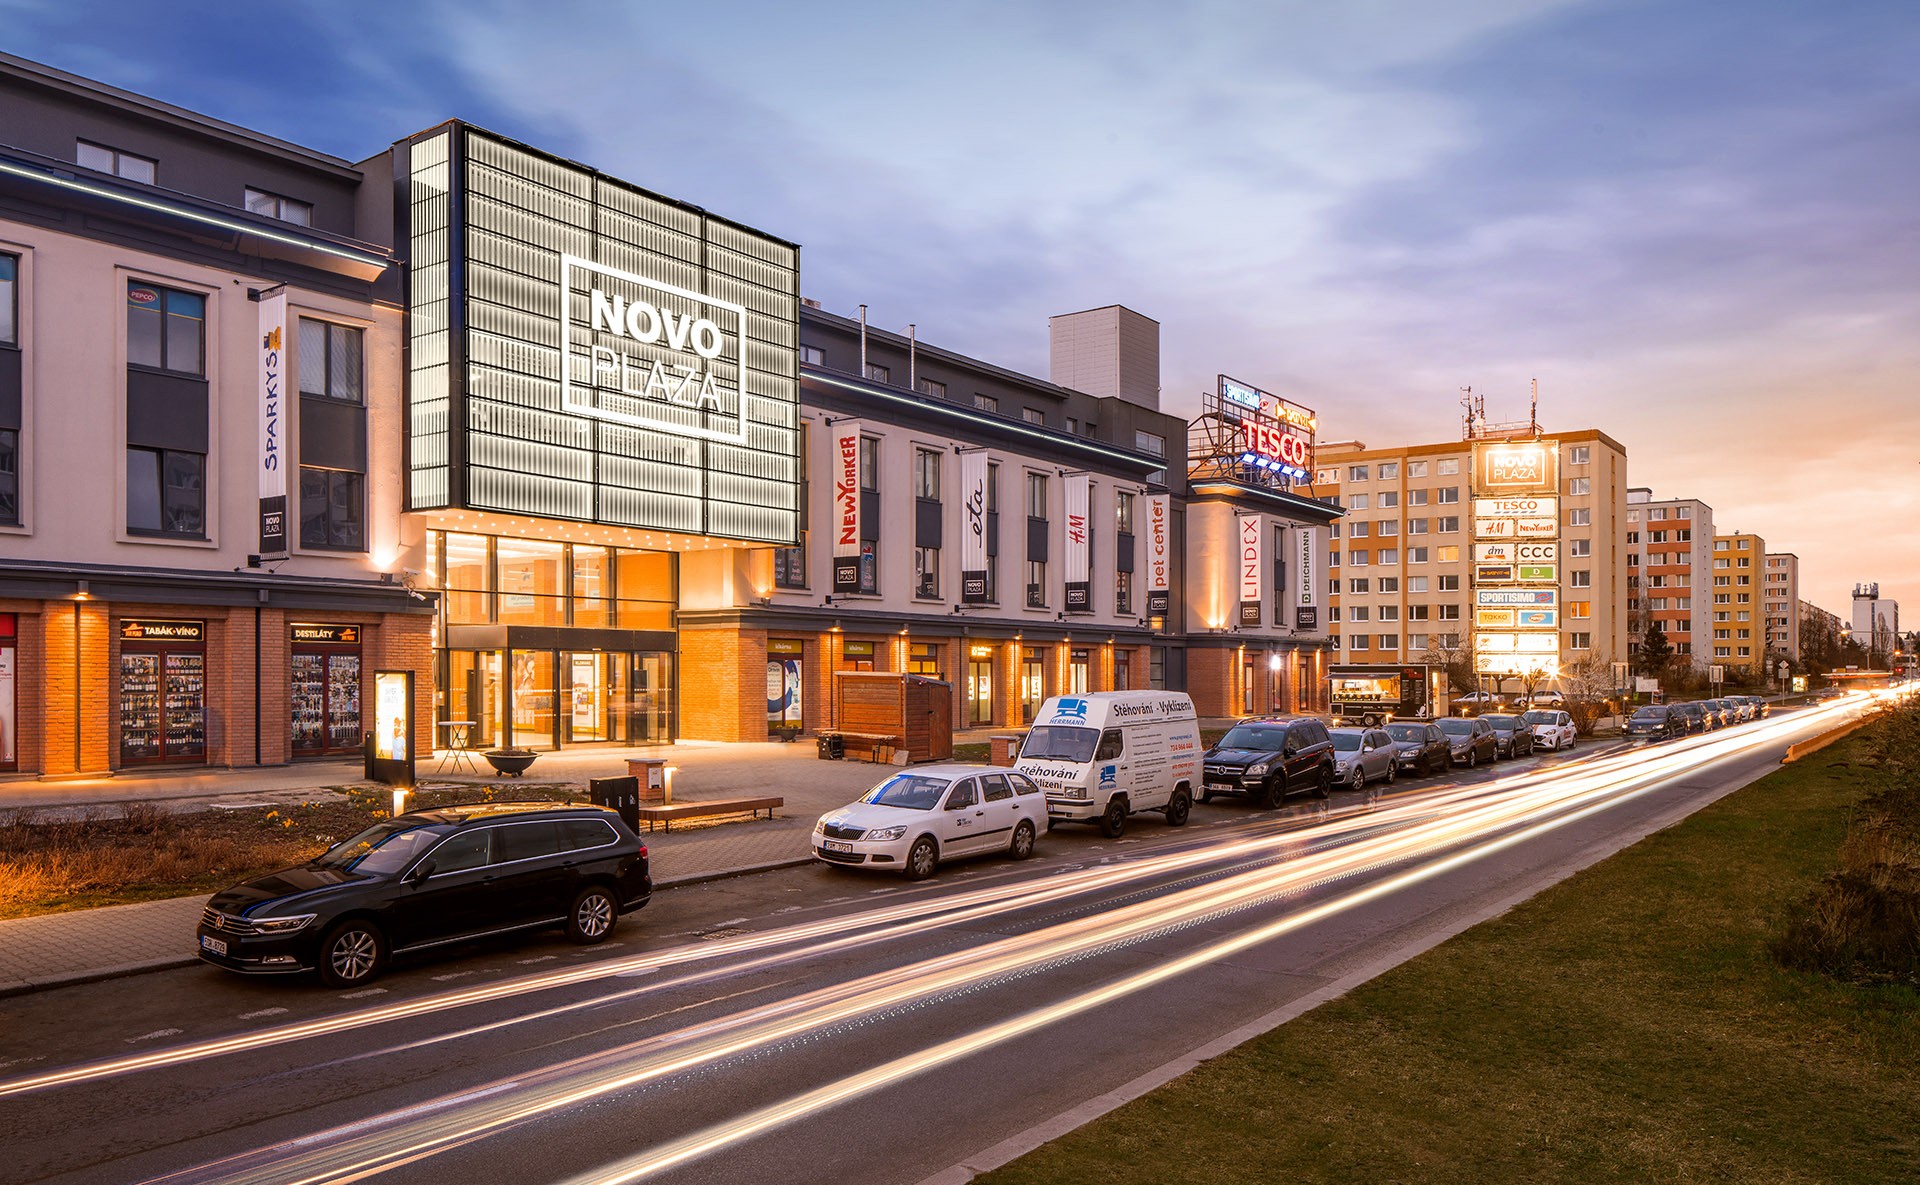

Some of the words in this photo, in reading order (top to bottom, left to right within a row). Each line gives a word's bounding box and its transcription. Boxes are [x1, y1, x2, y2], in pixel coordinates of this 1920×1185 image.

[131, 291, 153, 301] PEPCO
[590, 288, 723, 359] NOVO
[591, 343, 723, 413] PLAZA
[265, 350, 278, 471] SPARKYS
[1241, 418, 1306, 466] TESCO
[1494, 456, 1537, 468] NOVO
[1494, 468, 1537, 480] PLAZA
[837, 435, 856, 545] NEWYORKER
[1493, 500, 1538, 510] TESCO
[265, 516, 280, 525] NOVO
[966, 479, 983, 548] eta
[265, 524, 280, 533] PLAZA
[1069, 514, 1086, 545] H&M
[1152, 500, 1164, 556] center
[1485, 522, 1505, 535] H&M
[1487, 546, 1504, 555] dm
[1520, 546, 1553, 558] CCC
[1243, 520, 1257, 598] LINDEX
[1153, 560, 1167, 587] pet
[1480, 592, 1535, 603] SPORTISIMO
[295, 629, 334, 638] DESTILÁTY
[1113, 702, 1154, 717] Stěhování
[1159, 699, 1192, 716] Vyklízení
[1049, 718, 1087, 726] HERRMANN
[1020, 763, 1079, 780] Stěhování
